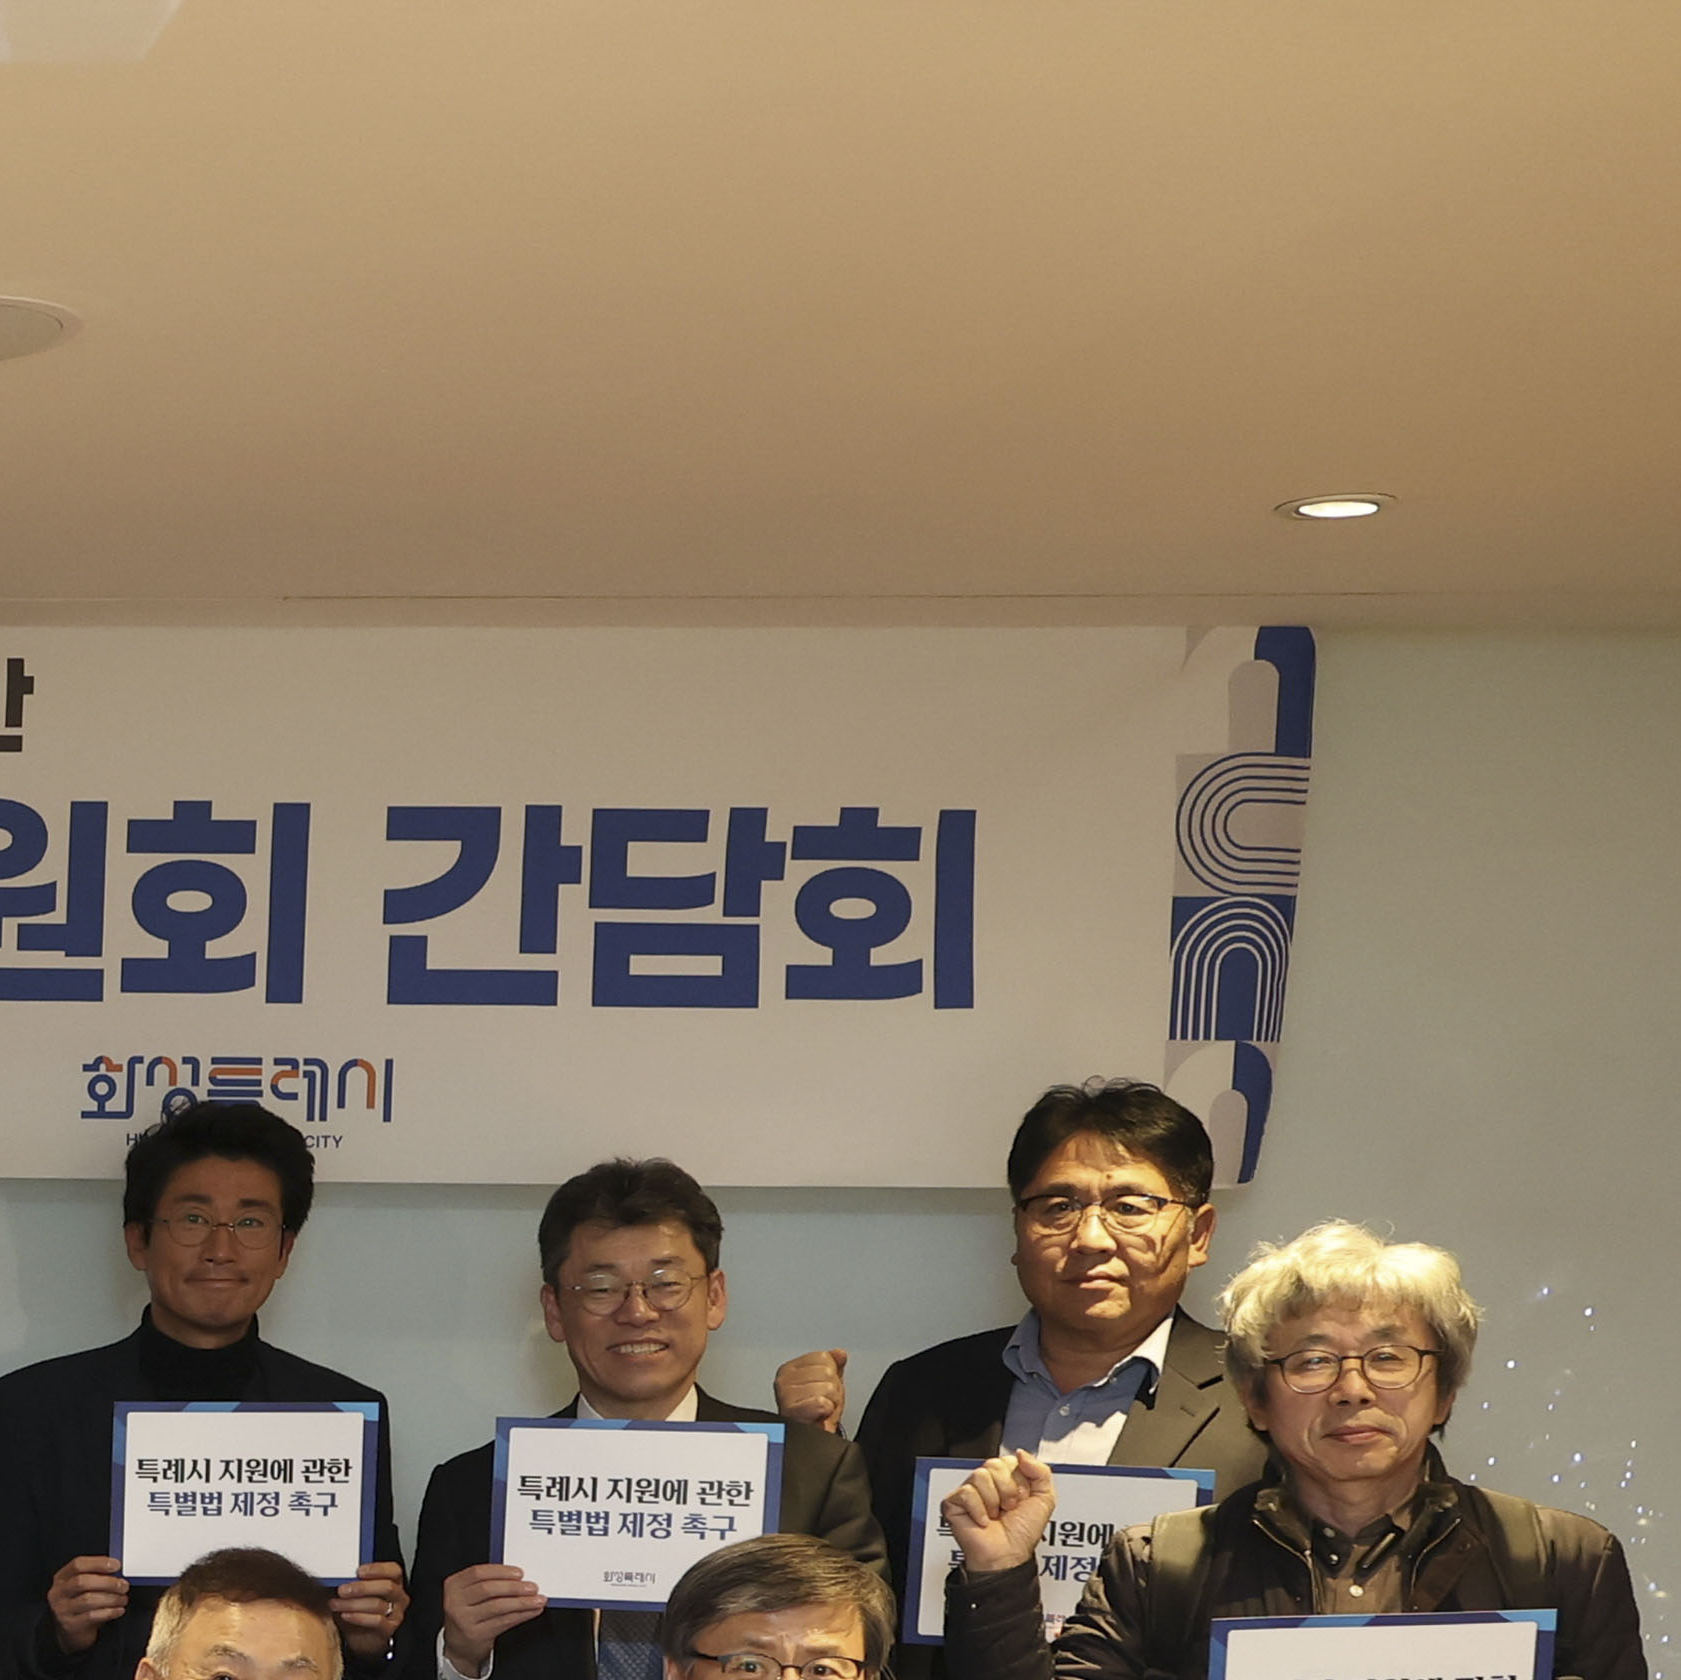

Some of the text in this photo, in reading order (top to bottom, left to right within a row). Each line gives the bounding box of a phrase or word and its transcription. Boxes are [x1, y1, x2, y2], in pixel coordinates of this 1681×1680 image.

[383, 805, 977, 1009] 간담회
[136, 1458, 352, 1483] 특례시 지원에 관한
[148, 1491, 338, 1517] 특별법 제정 촉구
[518, 1476, 754, 1507] 특례시 지원에 관한
[529, 1510, 737, 1542] 특별법 제정 촉구
